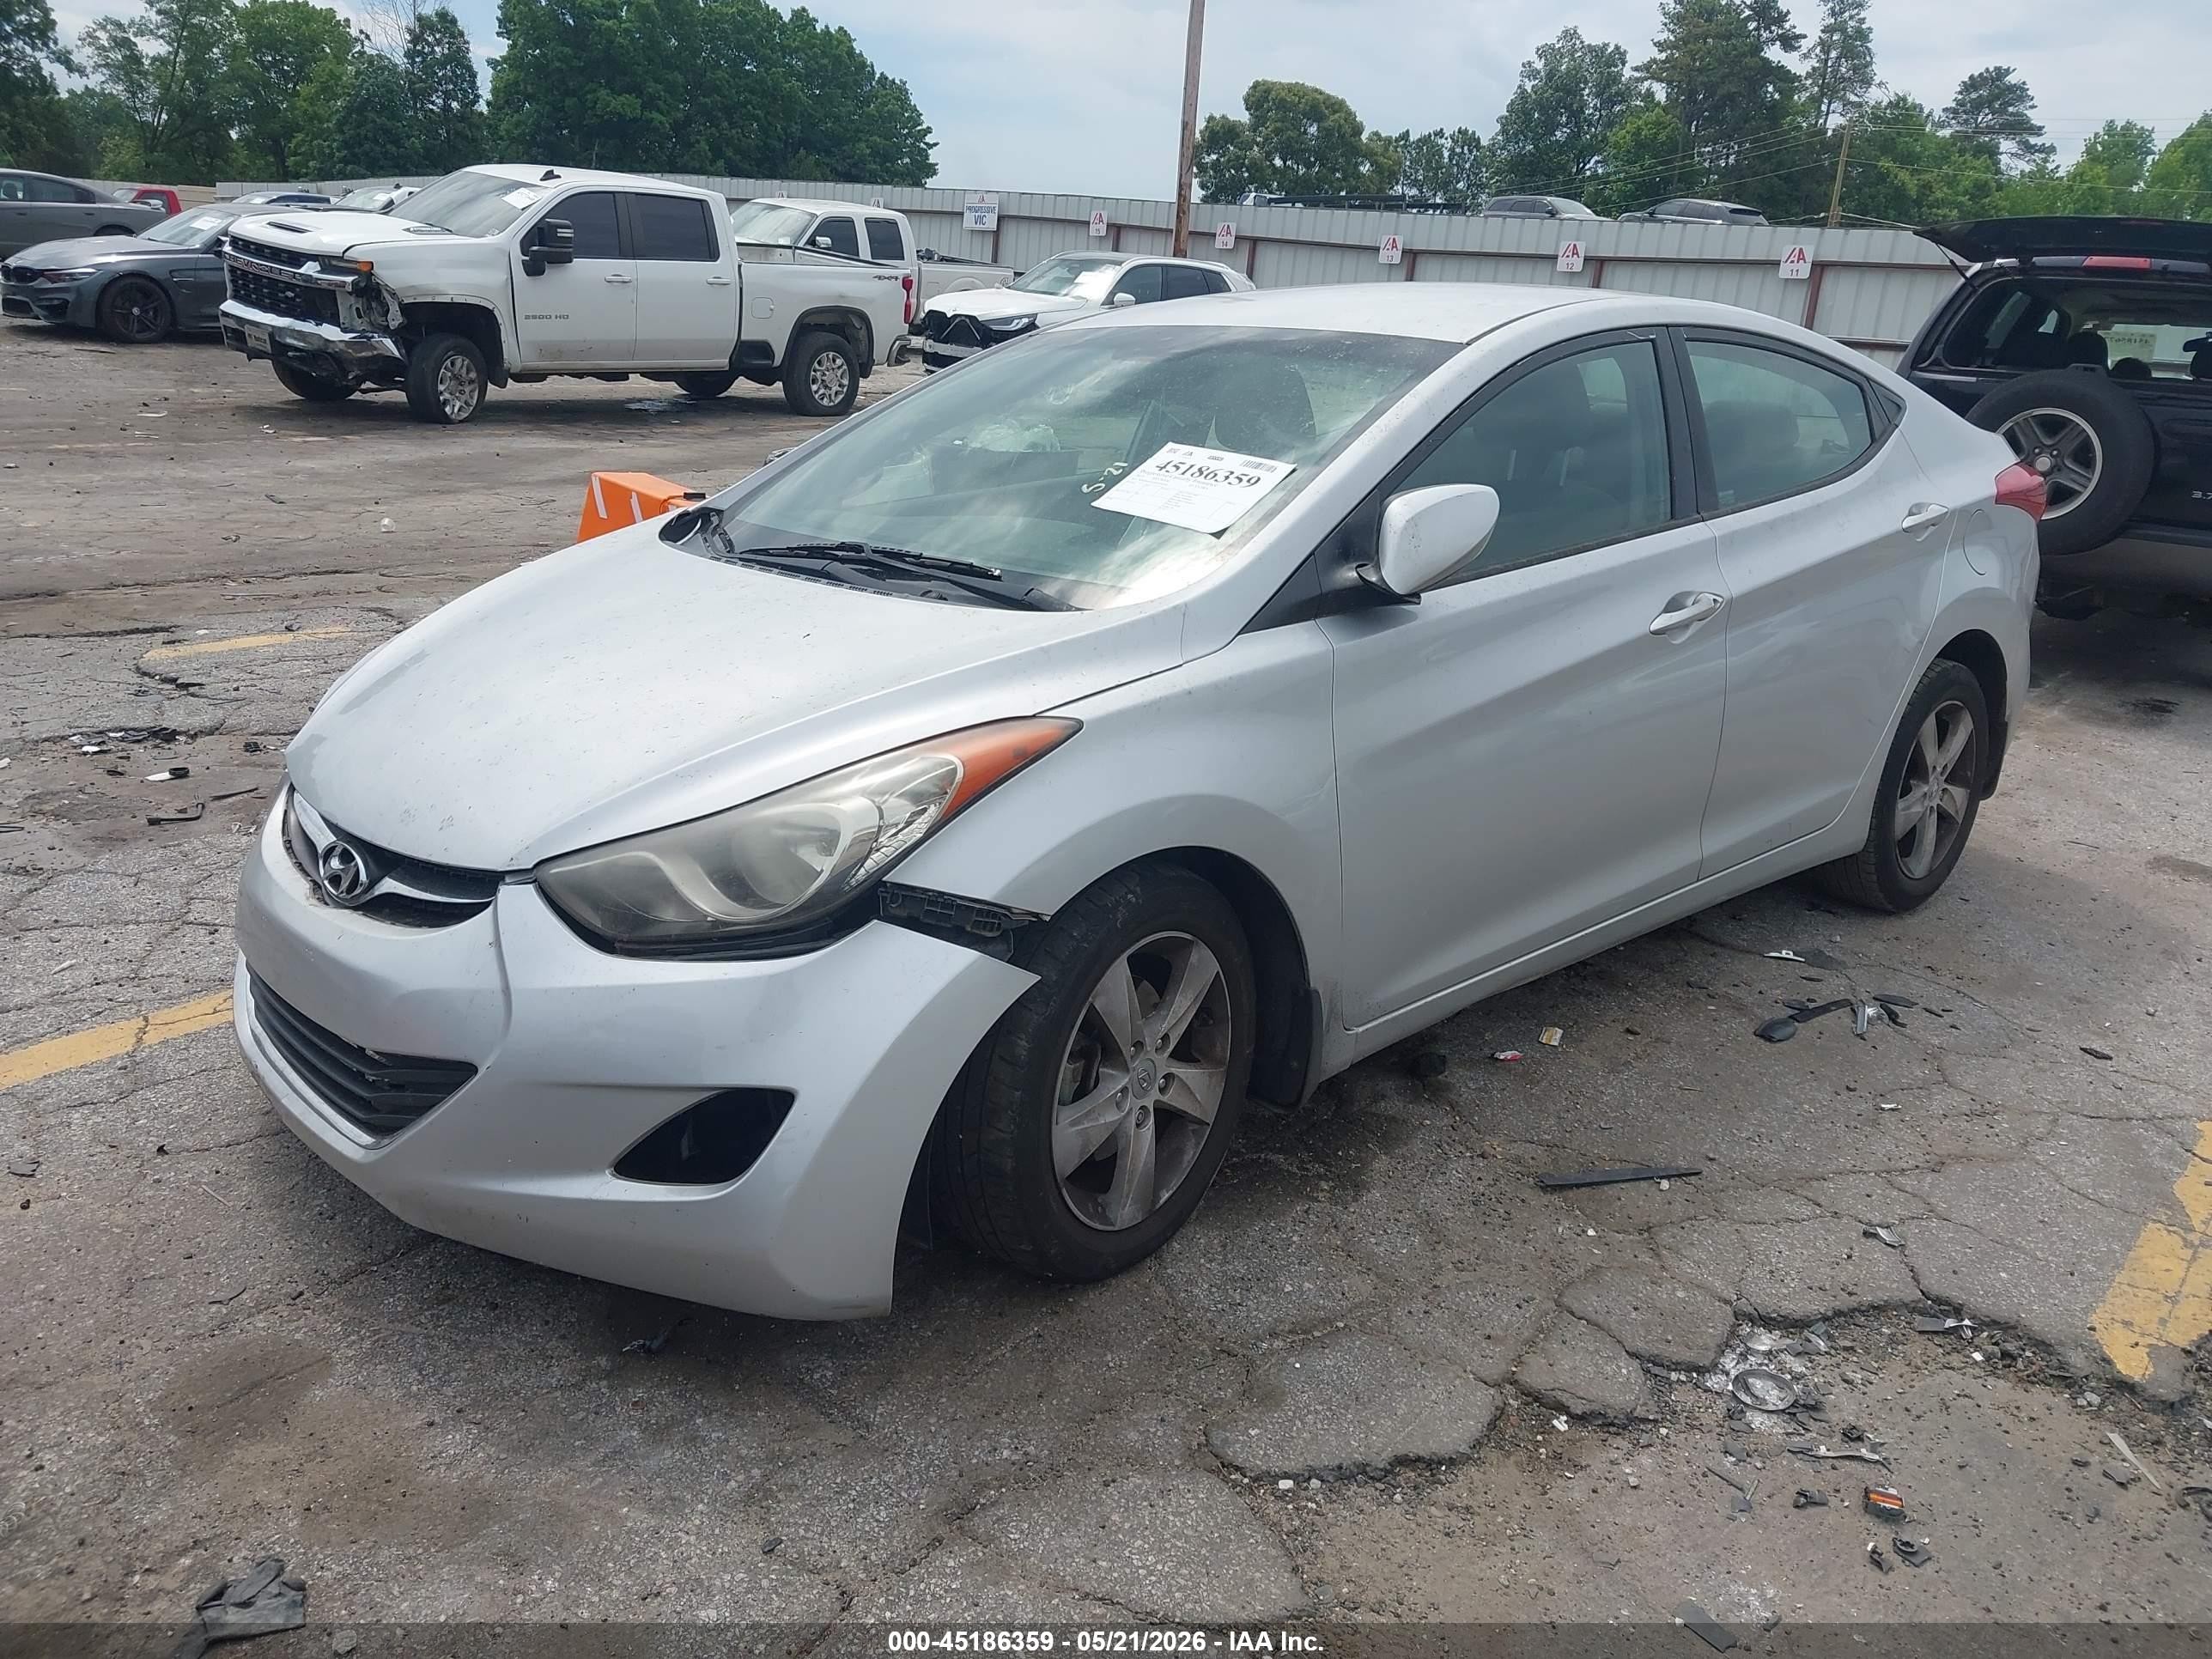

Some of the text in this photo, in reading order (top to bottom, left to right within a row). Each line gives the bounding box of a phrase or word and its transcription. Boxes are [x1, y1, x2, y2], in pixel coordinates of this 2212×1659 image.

[974, 214, 987, 225] VIC
[1789, 268, 1799, 276] 11
[1155, 460, 1261, 488] 45186359
